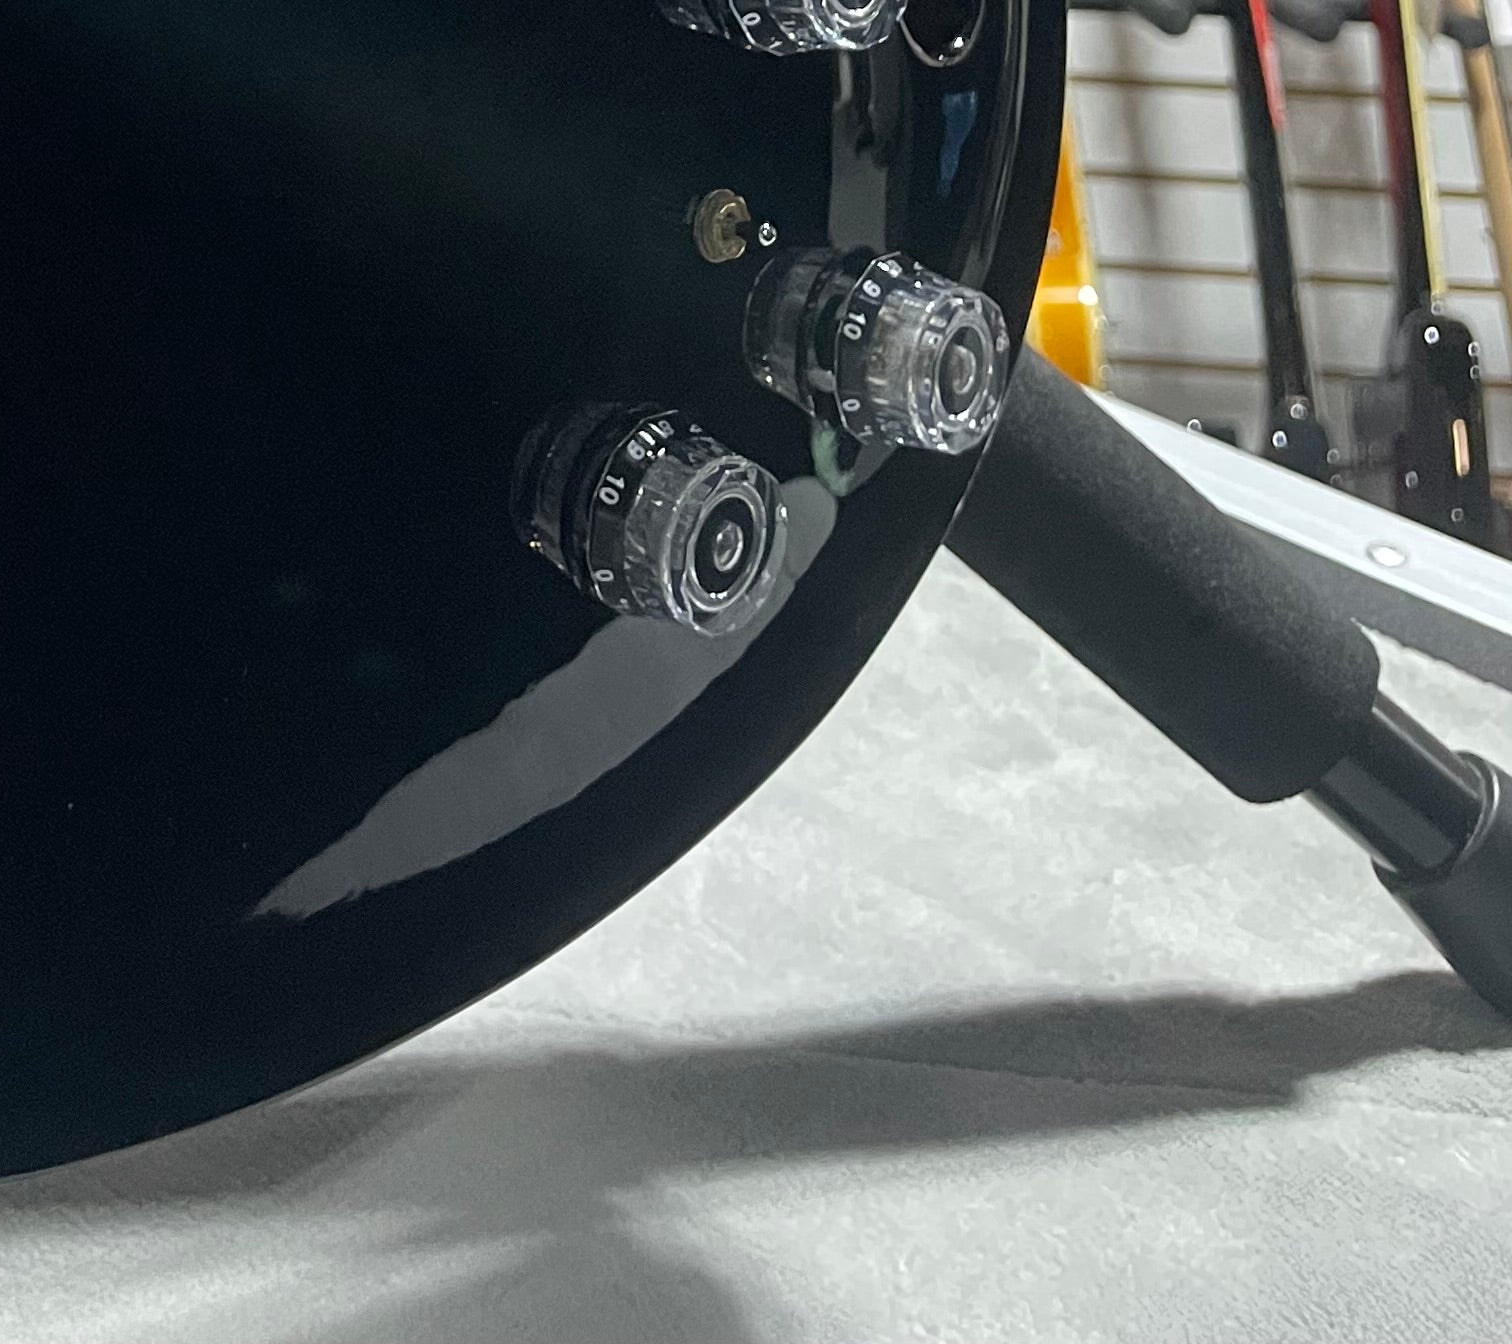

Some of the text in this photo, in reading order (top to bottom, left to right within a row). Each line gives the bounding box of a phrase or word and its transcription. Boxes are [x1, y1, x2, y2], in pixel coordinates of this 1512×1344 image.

[741, 11, 762, 27] 0
[862, 278, 882, 298] 9
[842, 312, 867, 341] 10
[842, 398, 861, 412] 0
[626, 439, 646, 461] 9
[599, 475, 625, 505] 10
